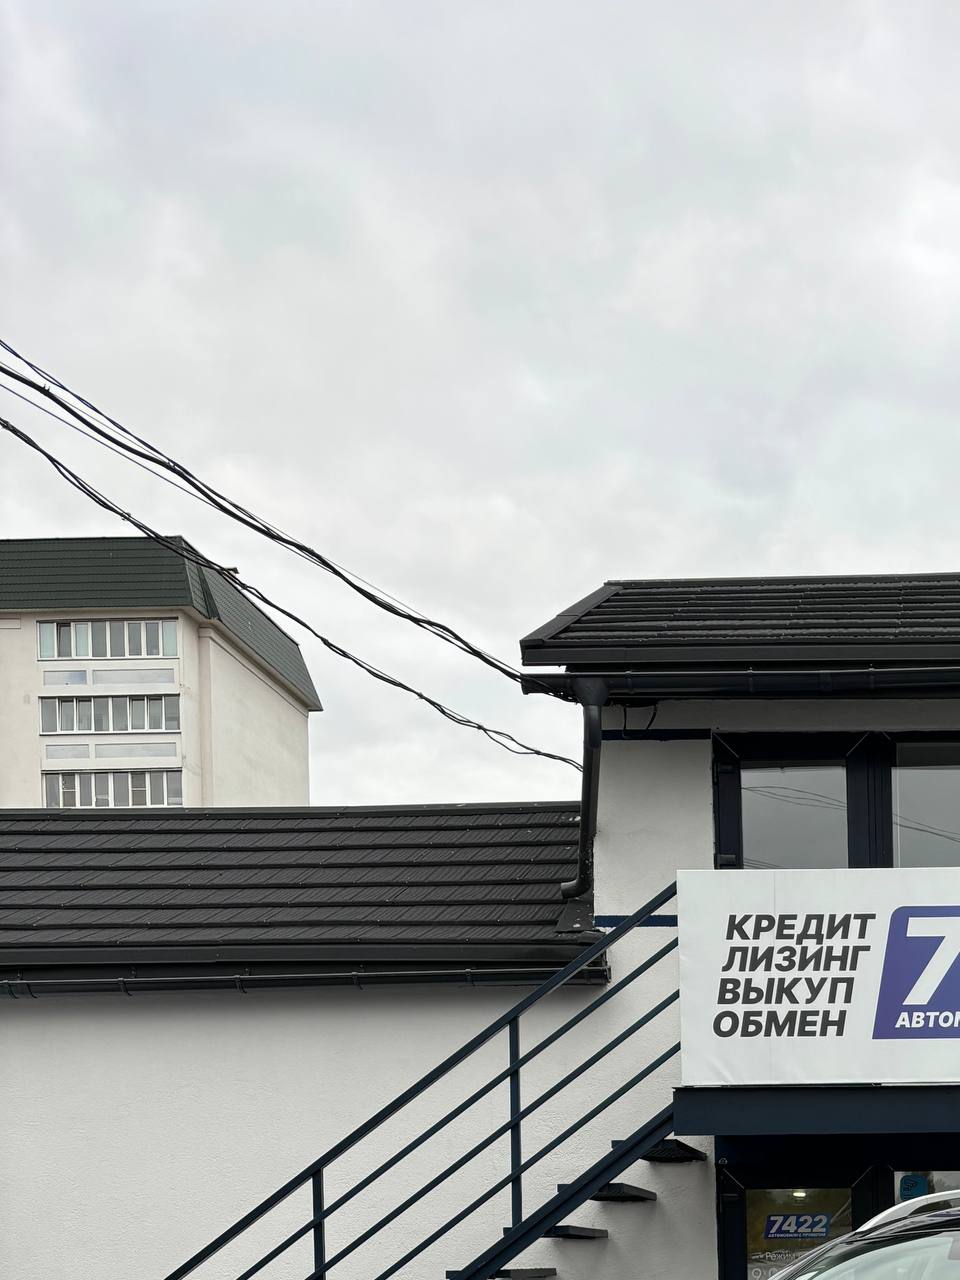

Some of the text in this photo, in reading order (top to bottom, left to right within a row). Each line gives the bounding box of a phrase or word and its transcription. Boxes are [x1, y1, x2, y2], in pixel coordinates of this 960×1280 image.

[725, 913, 876, 944] КРЕДИТ
[721, 945, 871, 973] ЛИЗИНГ
[717, 976, 855, 1005] ВЫКУП
[712, 1009, 847, 1038] ОБМЕН
[769, 1214, 828, 1234] 7422
